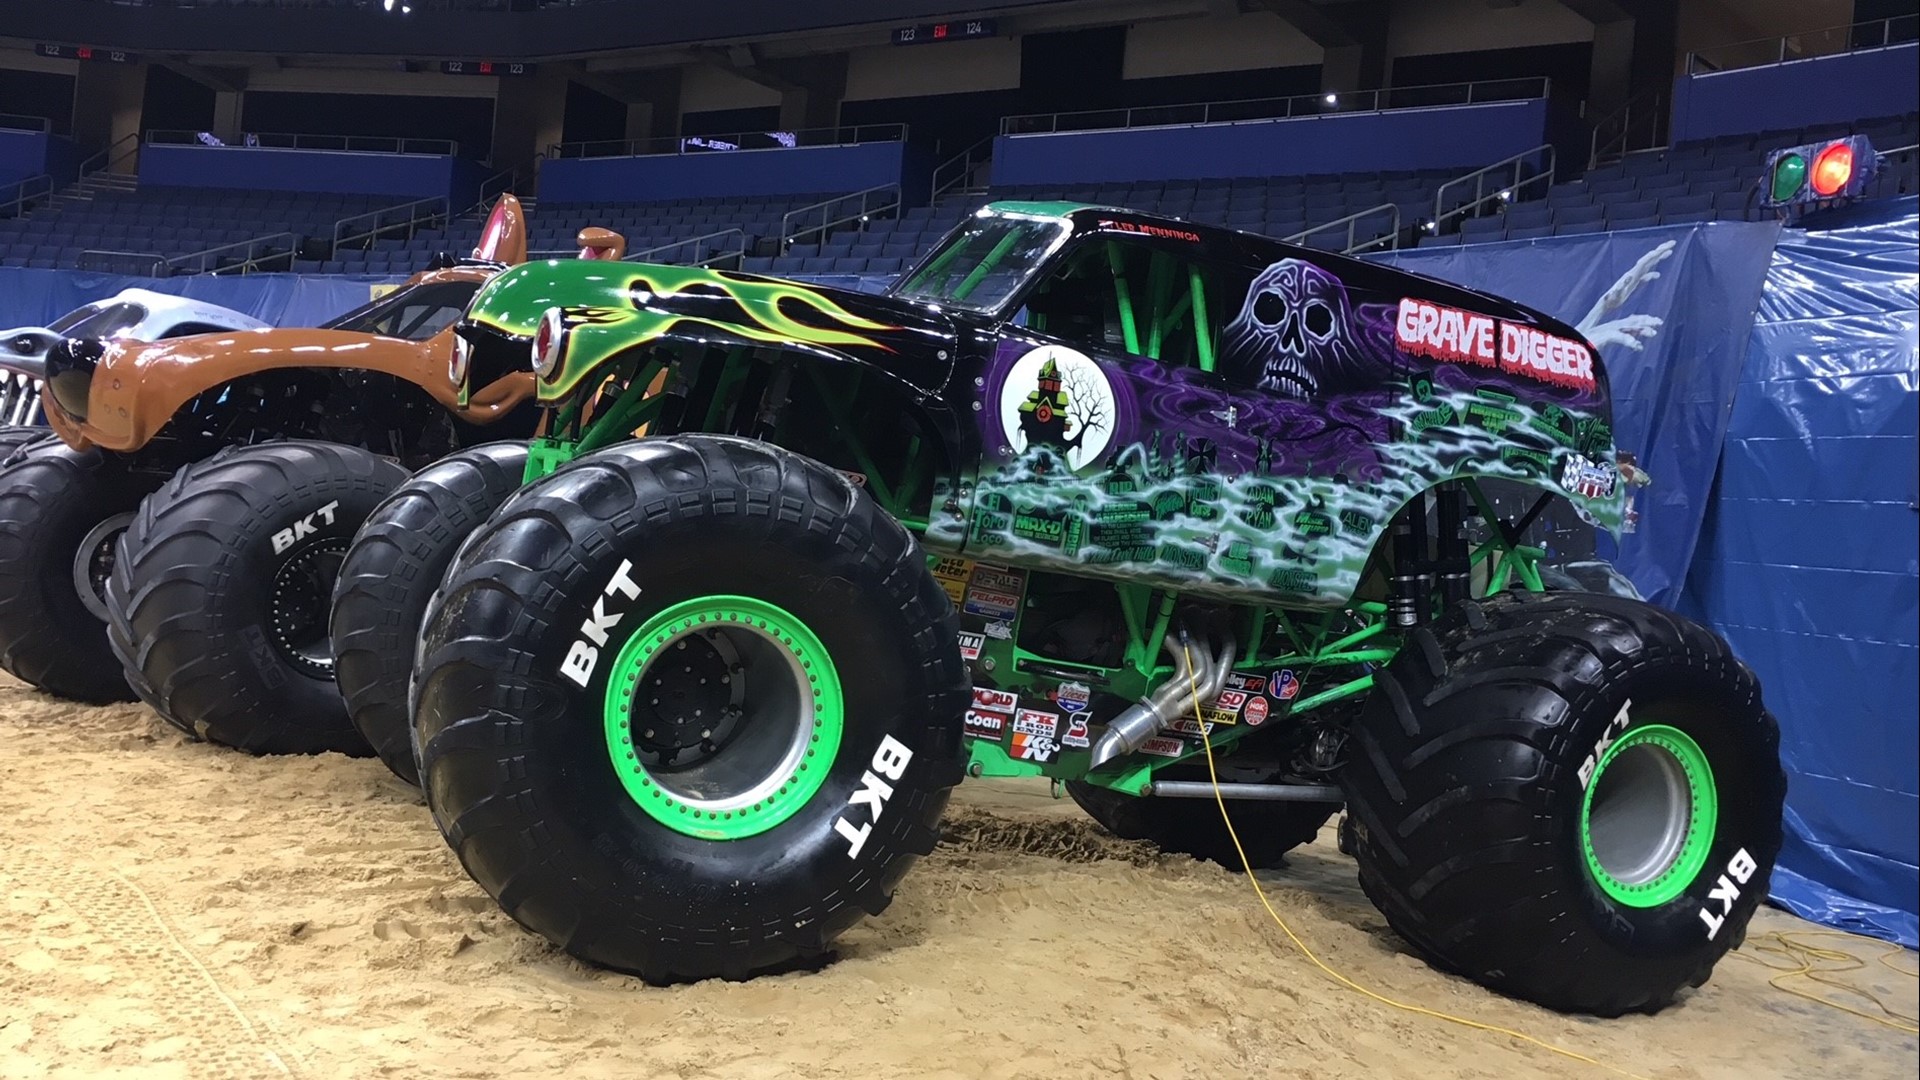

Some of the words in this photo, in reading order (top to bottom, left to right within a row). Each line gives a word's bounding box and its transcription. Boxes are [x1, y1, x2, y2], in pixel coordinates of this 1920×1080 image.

[900, 29, 916, 41] 123
[934, 24, 948, 39] EXIT
[966, 22, 982, 35] 124
[45, 45, 60, 56] 122
[110, 51, 126, 63] 122
[448, 62, 463, 73] 122
[509, 63, 524, 74] 123
[1138, 224, 1200, 242] MENNINGA
[1396, 298, 1495, 359] GRAVE
[1500, 322, 1594, 381] DIGGER
[1247, 486, 1275, 506] ADAM
[271, 500, 339, 556] BKT
[1016, 515, 1061, 535] MAX-D
[1245, 510, 1272, 529] RYAN
[1342, 512, 1373, 531] ALIEN
[970, 590, 1015, 607] FEL-PRO
[559, 557, 642, 689] BKT
[958, 634, 980, 649] IMA
[1273, 669, 1294, 698] VP
[972, 689, 1014, 706] WORLD
[1248, 702, 1266, 713] NGK
[965, 710, 1002, 730] Coan
[1026, 722, 1054, 732] ROD
[1016, 726, 1053, 738] ENDS
[1141, 740, 1179, 754] SIMPSON
[1576, 698, 1634, 792] BKT
[833, 733, 914, 861] BKT
[1697, 847, 1758, 941] BKT
